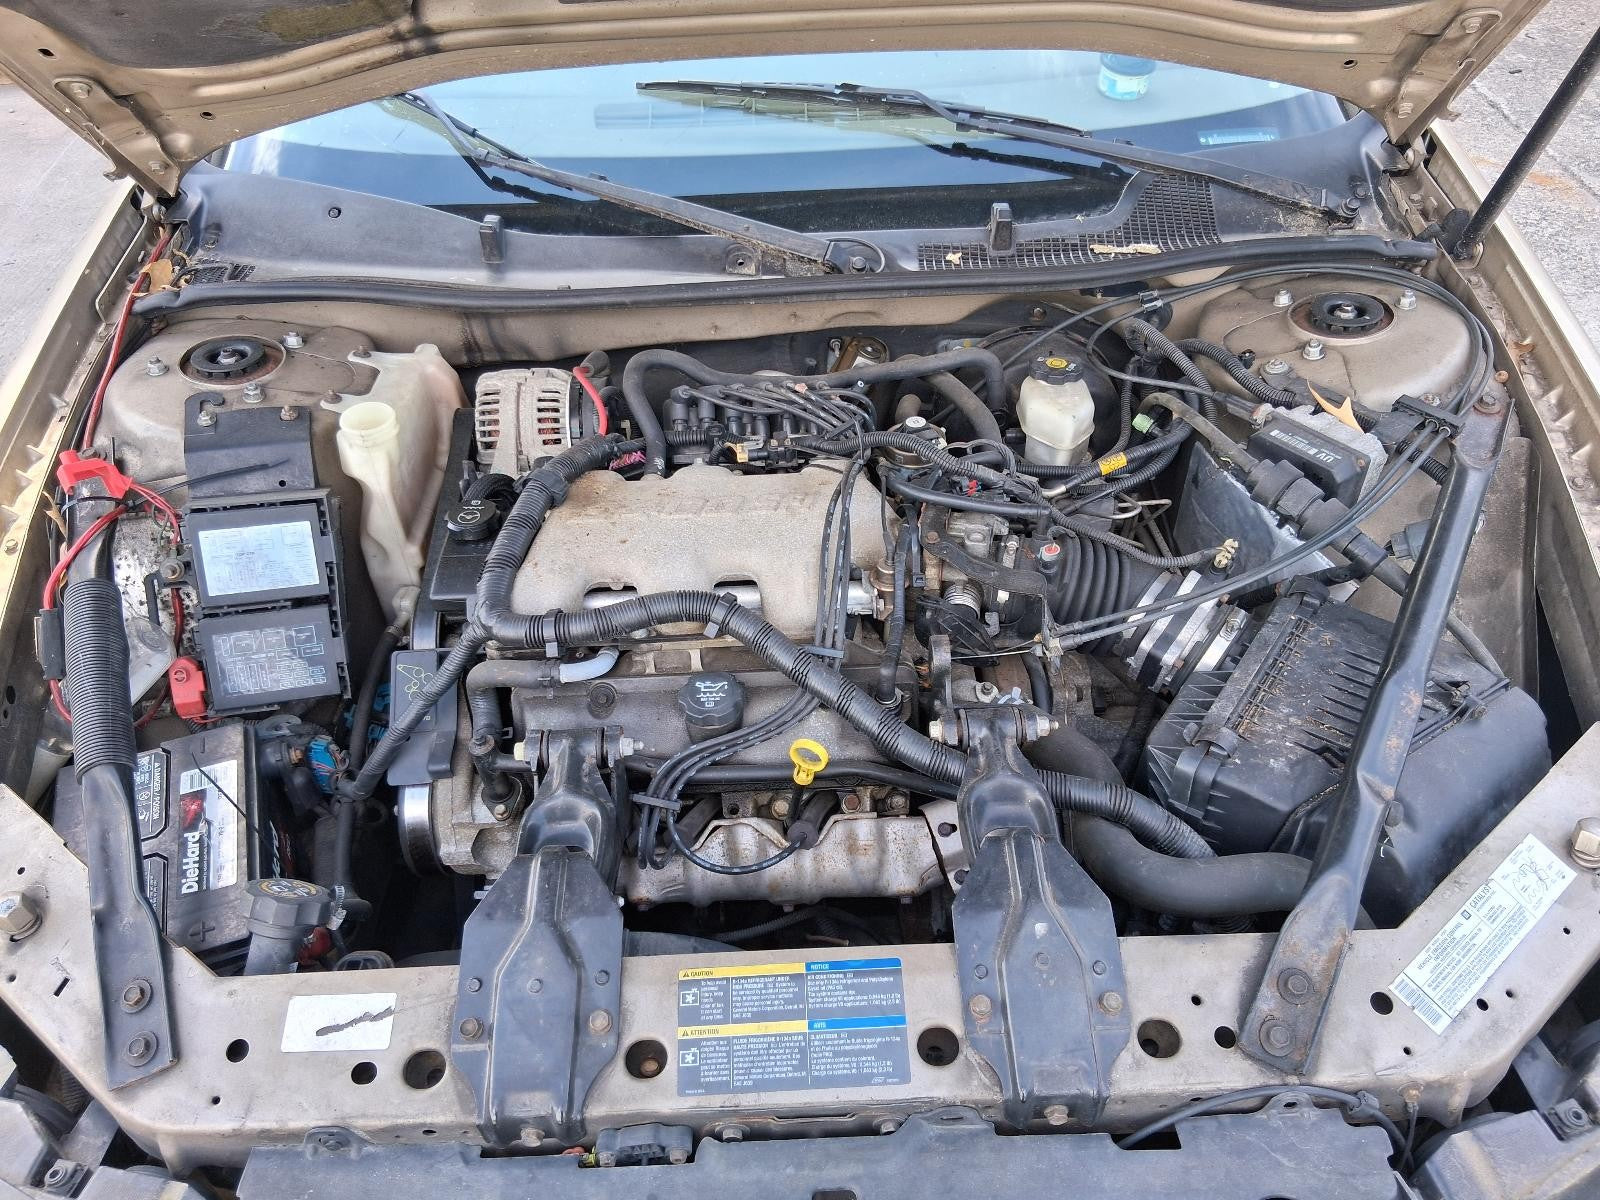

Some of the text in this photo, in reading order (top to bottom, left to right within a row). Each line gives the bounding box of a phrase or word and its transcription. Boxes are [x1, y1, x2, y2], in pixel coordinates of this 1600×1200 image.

[181, 832, 200, 894] DieHard
[1468, 883, 1492, 908] CATALYST
[1417, 953, 1433, 970] VEHICLE
[1430, 936, 1448, 955] EMISSION
[1446, 920, 1462, 938] CONTROL
[1433, 935, 1457, 962] INFORMATION
